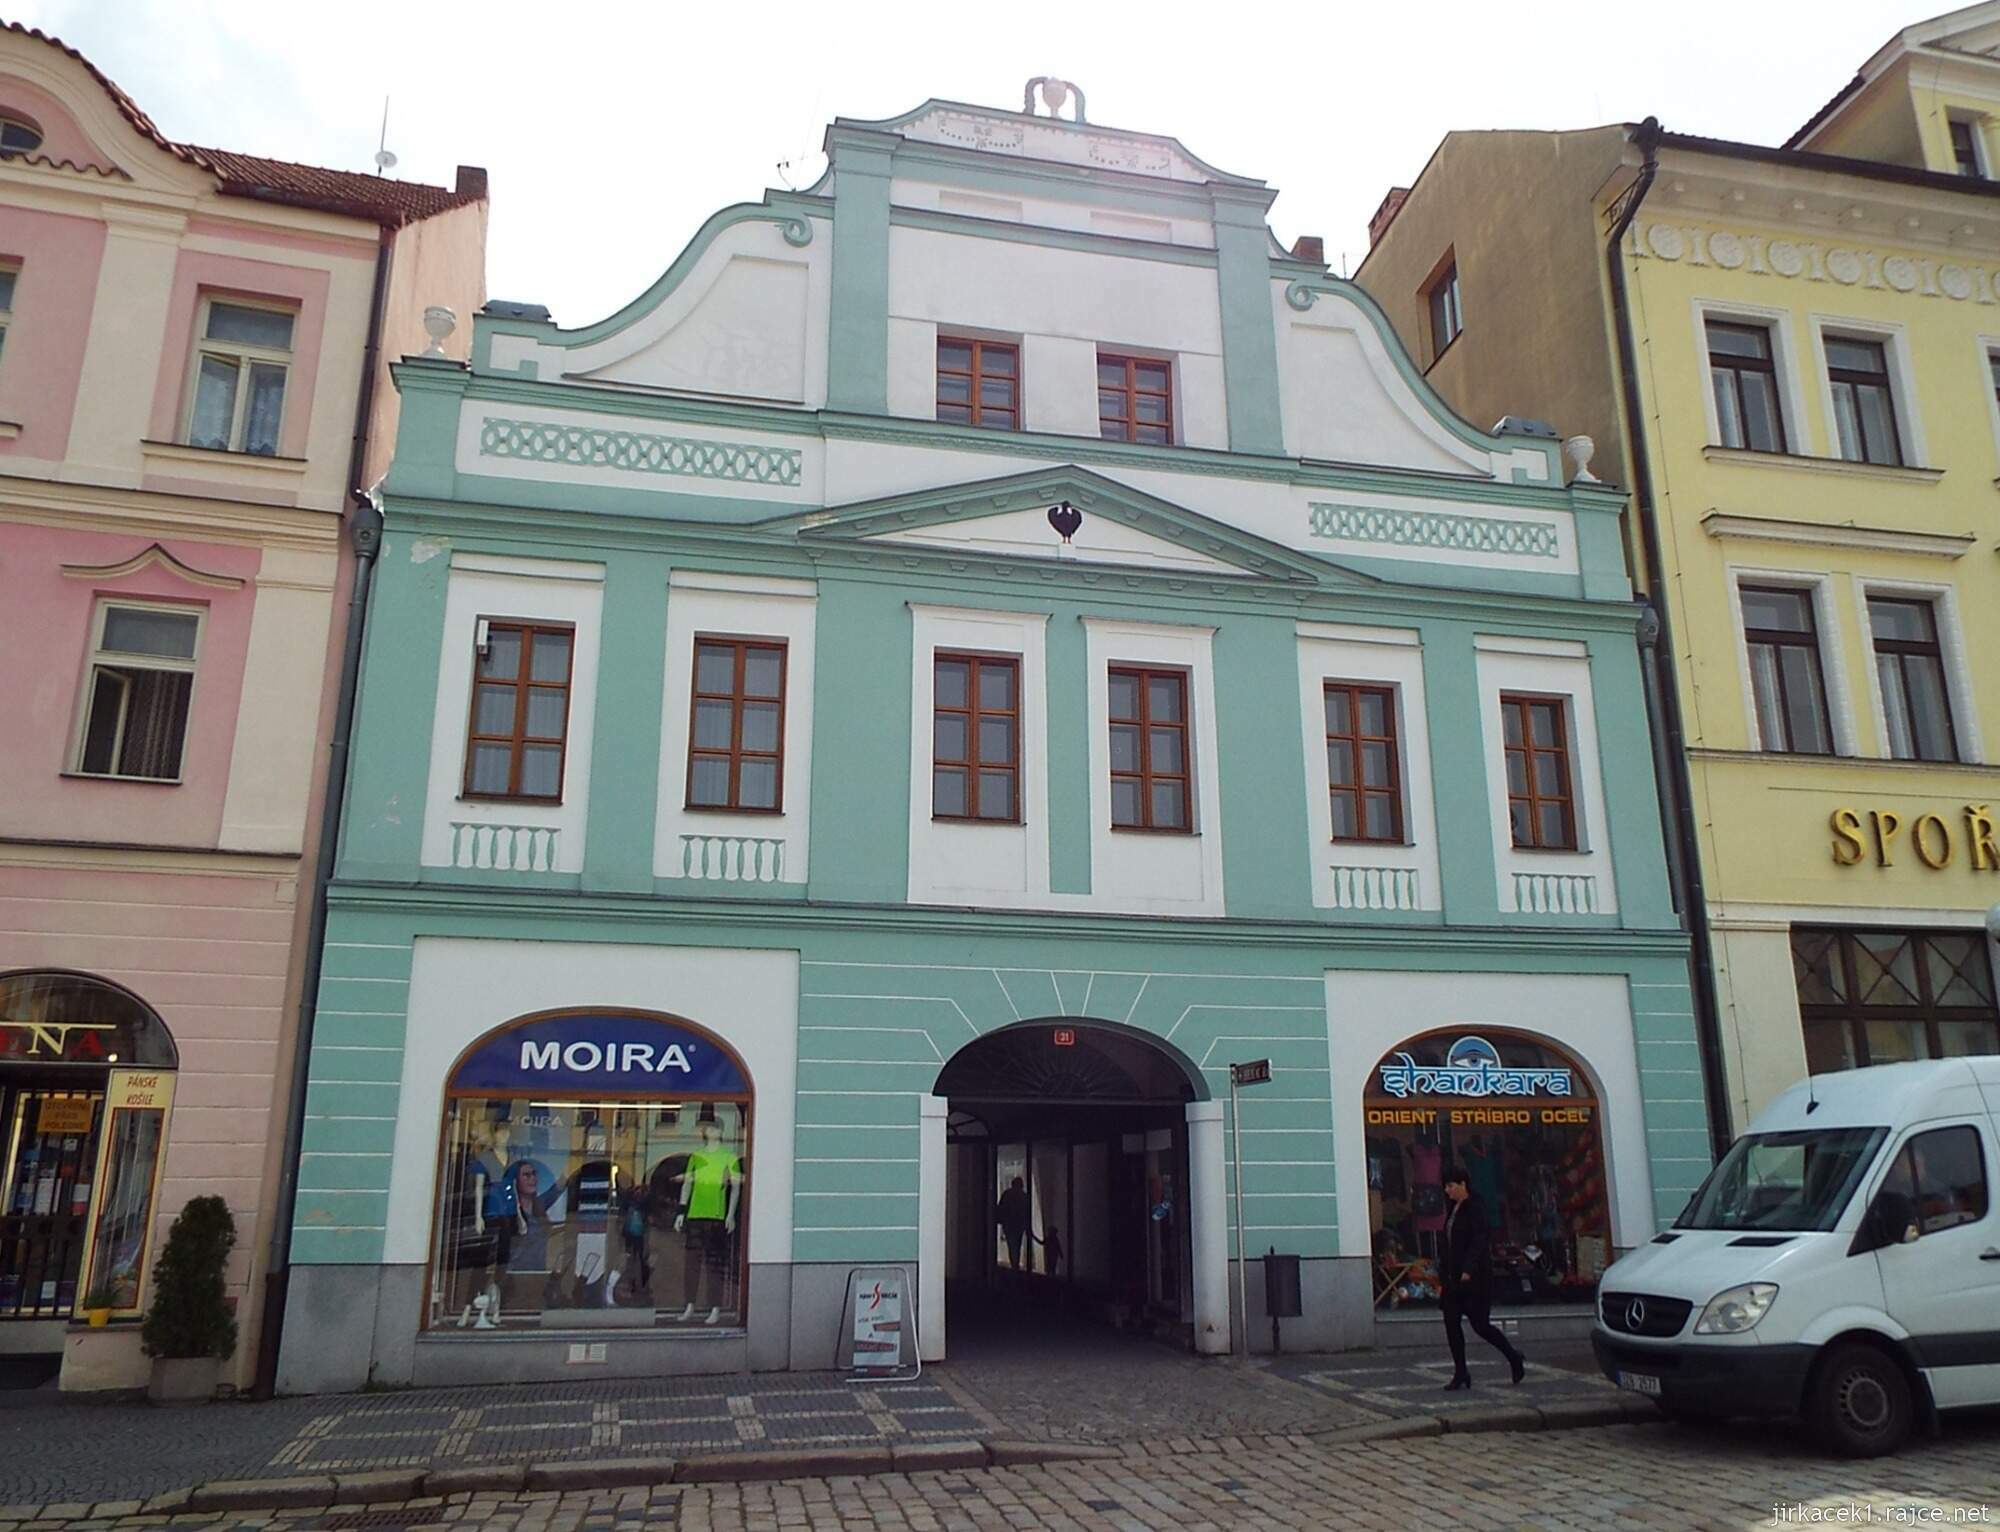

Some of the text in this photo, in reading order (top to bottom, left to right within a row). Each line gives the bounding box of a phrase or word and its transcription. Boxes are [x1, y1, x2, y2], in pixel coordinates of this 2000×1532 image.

[1829, 802, 2000, 871] SPOŘ
[520, 1041, 692, 1072] MOIRA
[1368, 1107, 1589, 1124] ORIENT STŘÍBRO OCEL
